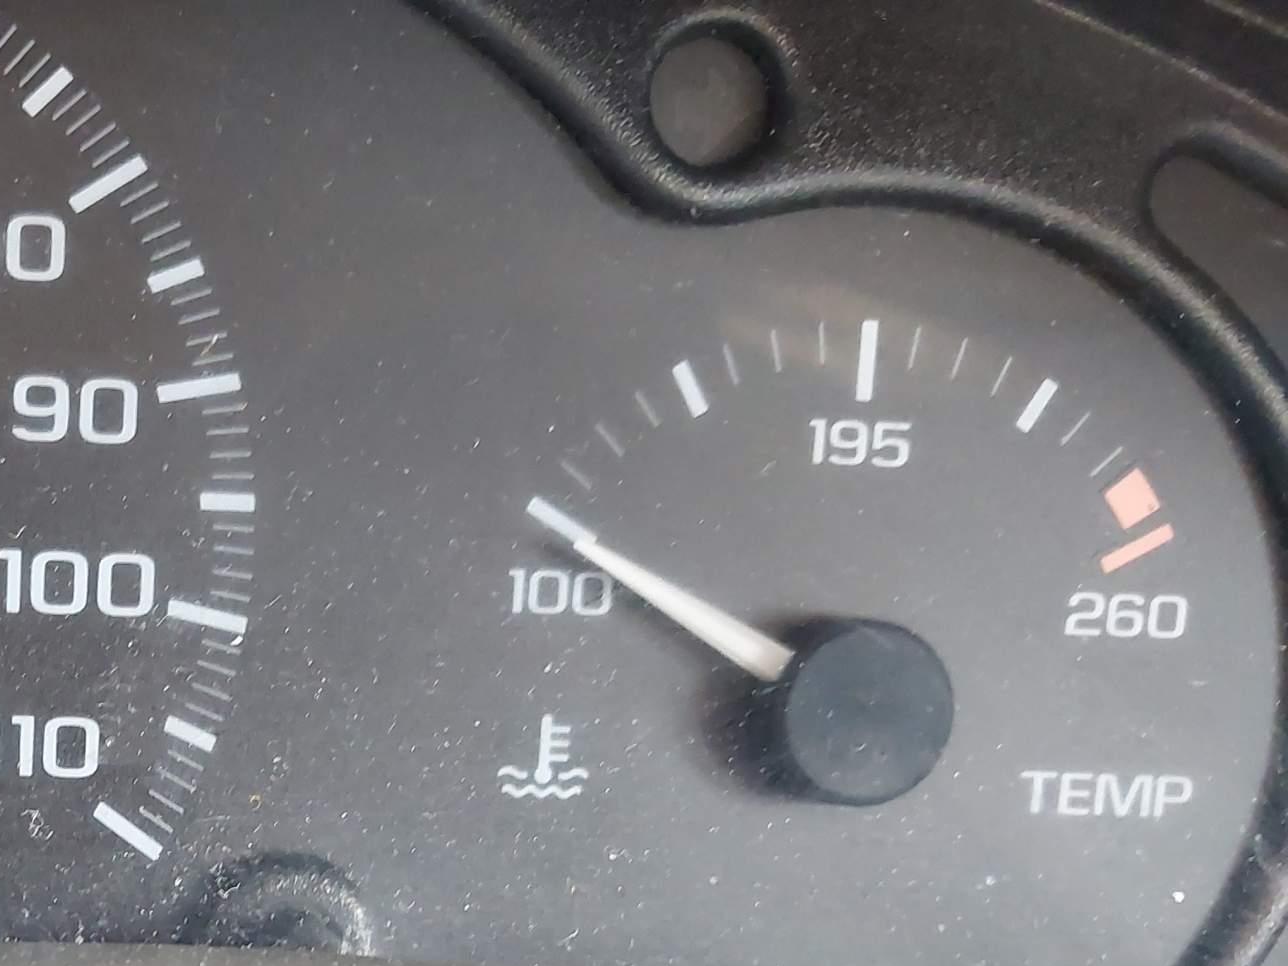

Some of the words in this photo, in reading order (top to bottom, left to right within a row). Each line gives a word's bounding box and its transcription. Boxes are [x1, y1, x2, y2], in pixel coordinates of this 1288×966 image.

[11, 375, 139, 446] 90
[809, 418, 912, 469] 195
[508, 567, 613, 618] 100
[1063, 592, 1189, 641] 260
[1020, 769, 1195, 821] TEMP
